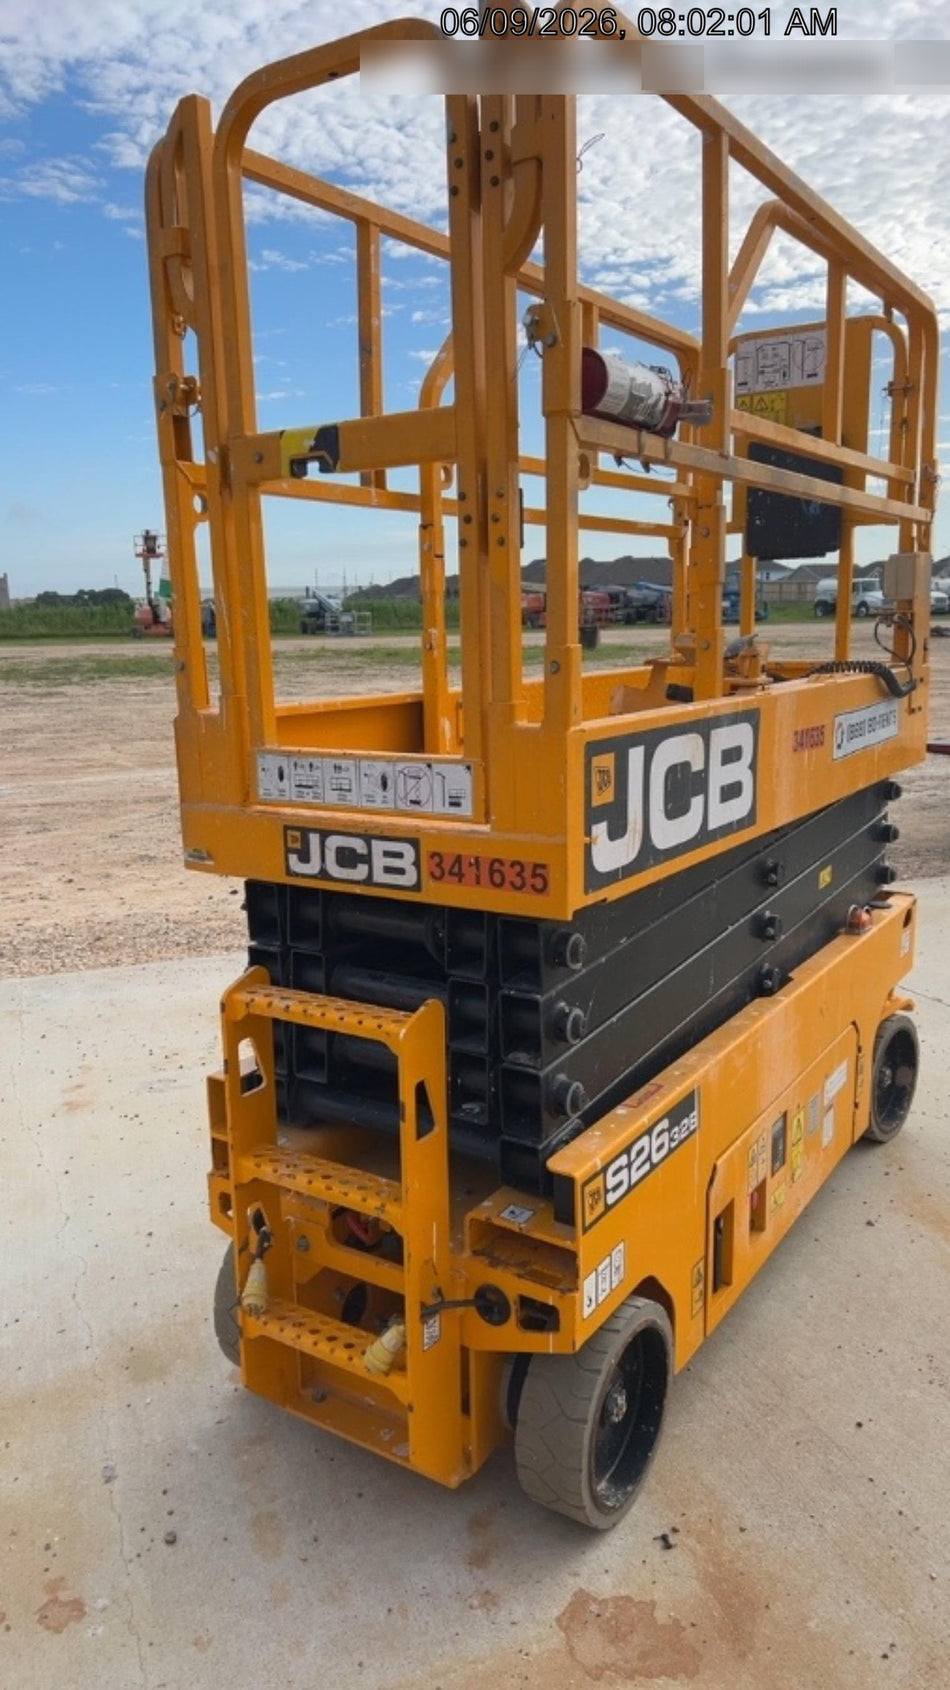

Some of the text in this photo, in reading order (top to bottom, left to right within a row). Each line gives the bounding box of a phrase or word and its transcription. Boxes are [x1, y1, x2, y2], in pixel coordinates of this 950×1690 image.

[591, 722, 754, 873] JCB
[287, 832, 419, 887] JCB
[429, 851, 549, 894] 341635
